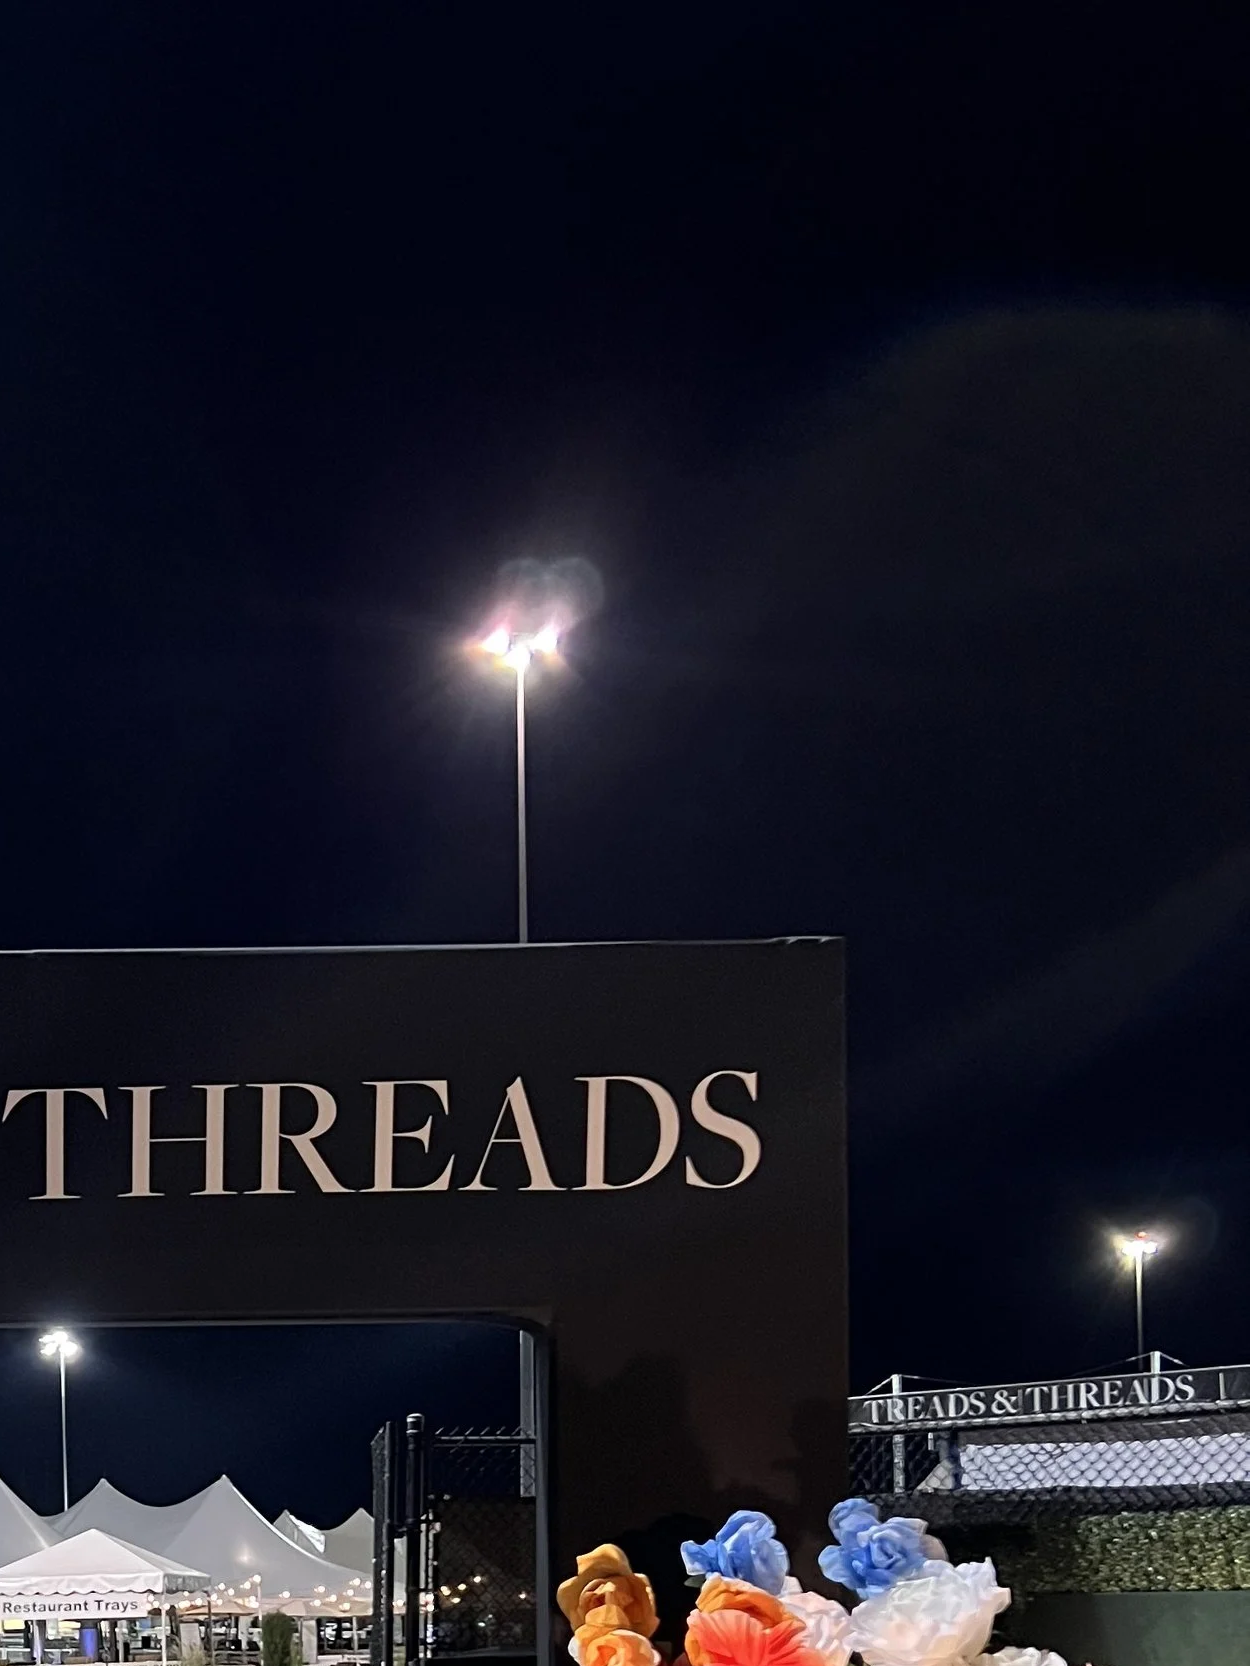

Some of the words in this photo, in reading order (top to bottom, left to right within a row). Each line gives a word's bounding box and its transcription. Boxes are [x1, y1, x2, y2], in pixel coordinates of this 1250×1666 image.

[1, 1070, 761, 1200] THREADS
[863, 1389, 986, 1424] TREADS
[990, 1388, 1018, 1415] &
[1025, 1374, 1196, 1413] THREADS
[2, 1600, 89, 1614] Restaurant
[94, 1599, 139, 1613] Trays
